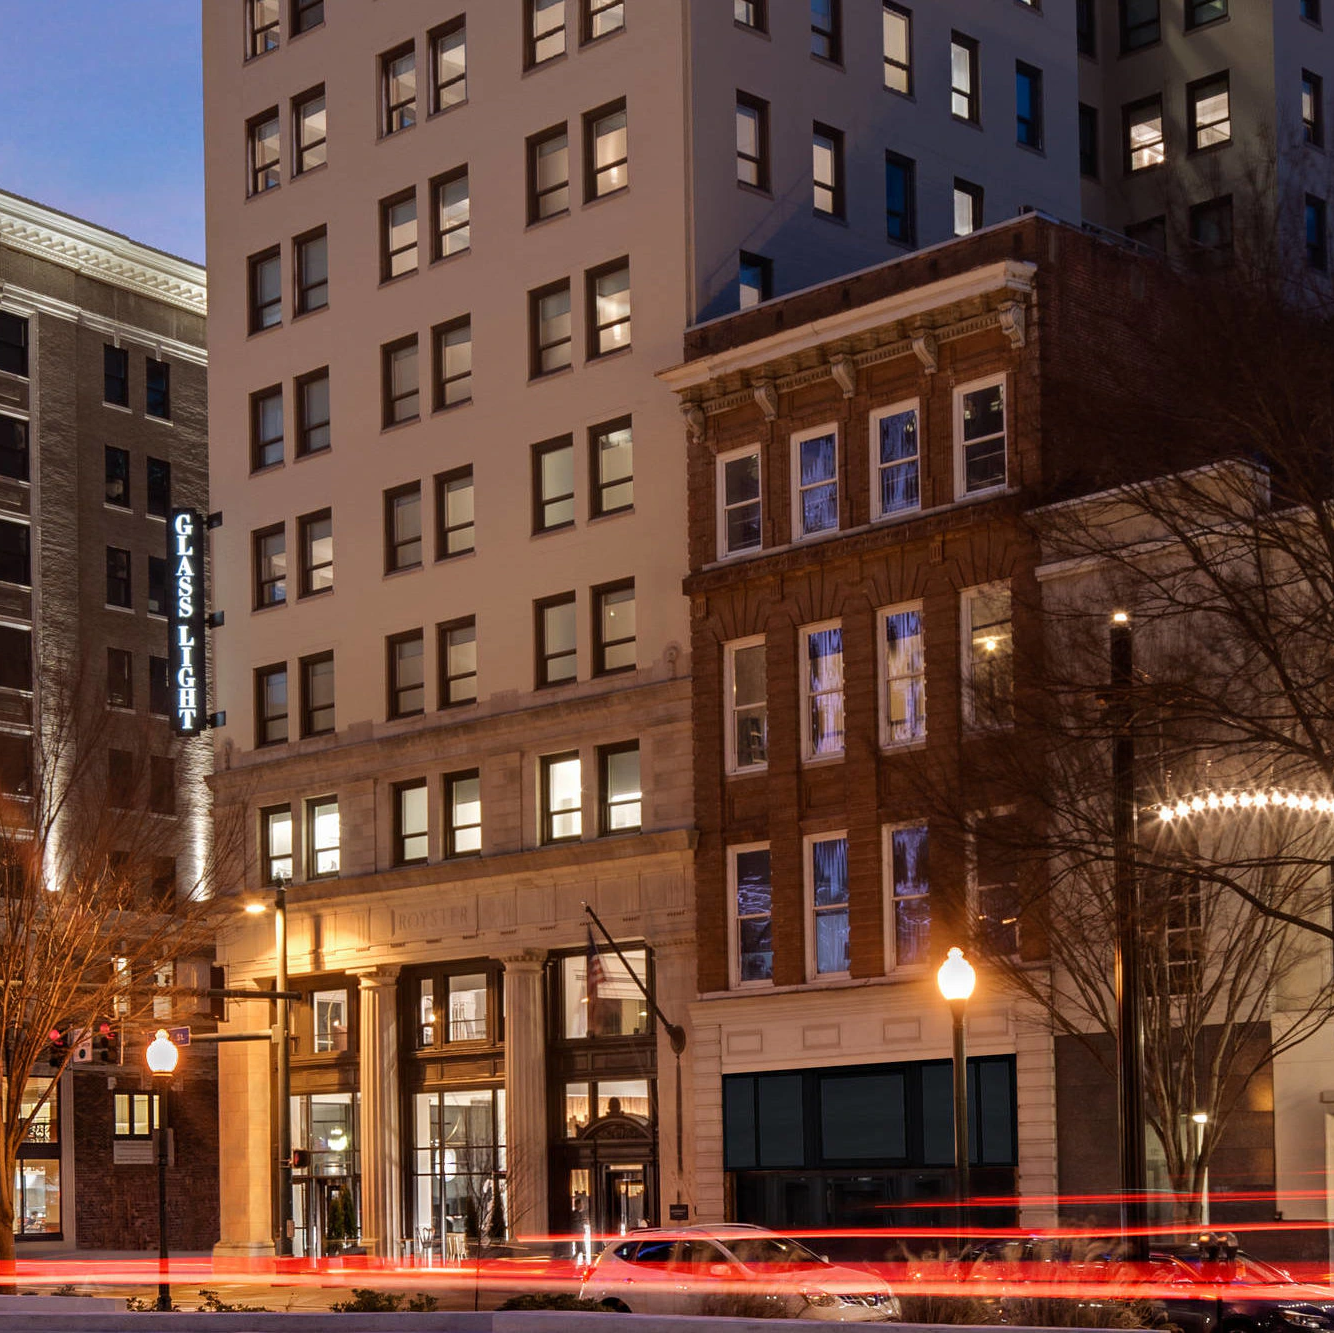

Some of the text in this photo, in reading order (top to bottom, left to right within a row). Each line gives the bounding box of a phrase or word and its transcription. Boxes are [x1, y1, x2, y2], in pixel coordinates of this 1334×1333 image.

[174, 513, 197, 730] GLASS LIGHT
[397, 907, 468, 930] ROYSTER
